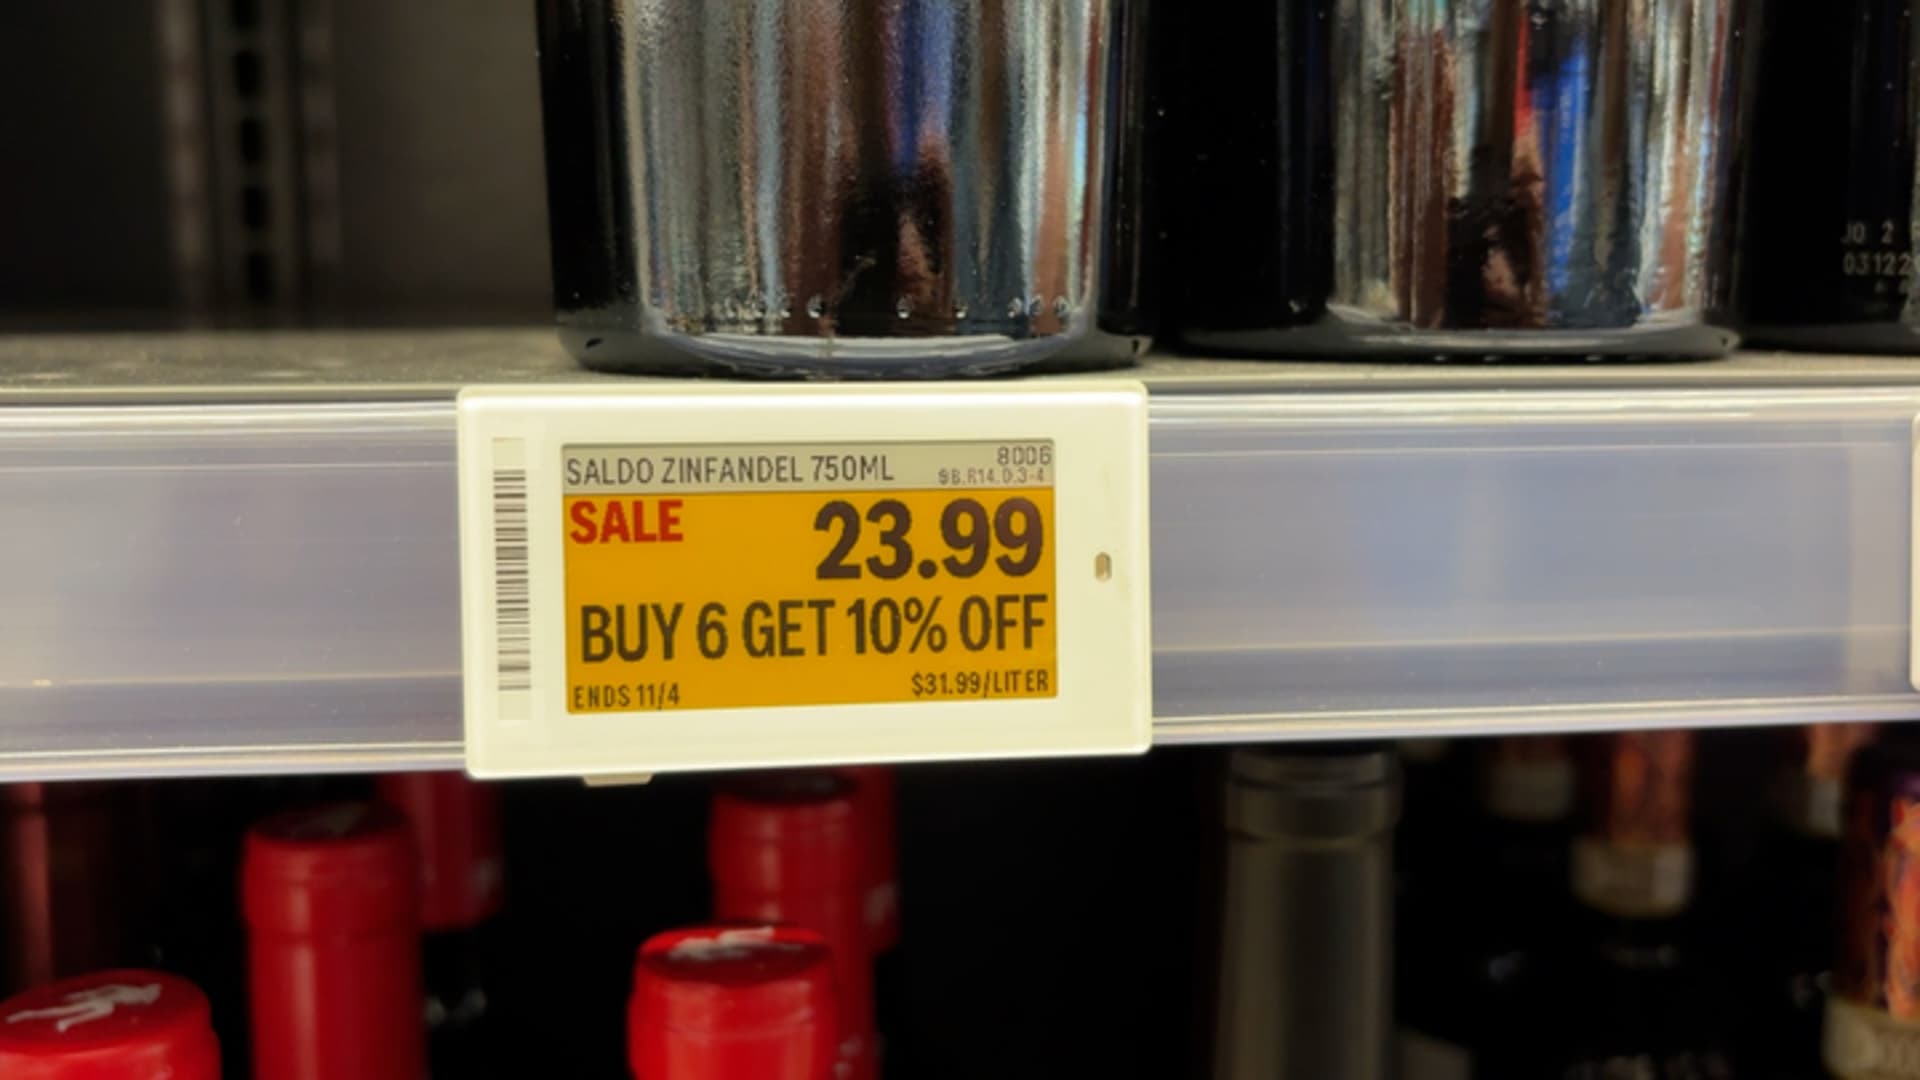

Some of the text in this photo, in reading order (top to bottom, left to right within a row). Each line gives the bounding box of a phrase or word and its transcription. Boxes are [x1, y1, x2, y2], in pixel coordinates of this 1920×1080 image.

[566, 454, 894, 486] SALDO ZINFANDEL 750ML
[997, 445, 1052, 466] 8006
[570, 499, 684, 545] SALE
[813, 497, 1044, 580] 23.99
[581, 593, 1048, 664] BUY 6 GET 10% OFF
[573, 682, 680, 711] ENDS 11/4
